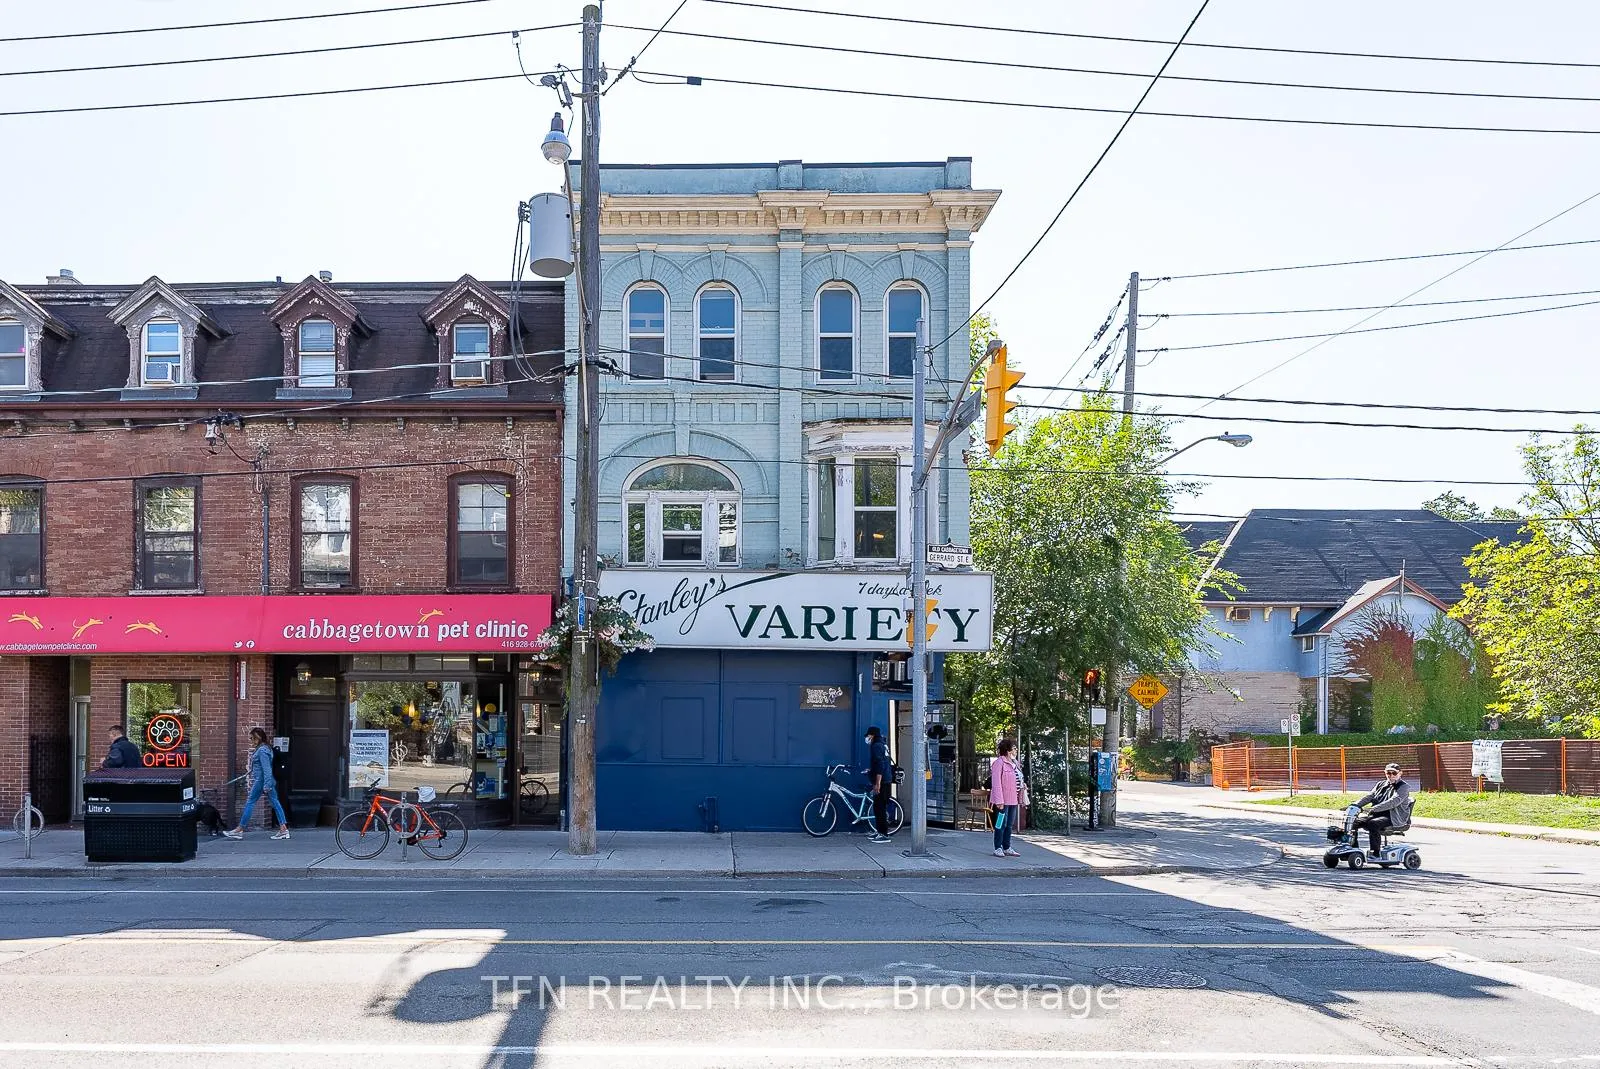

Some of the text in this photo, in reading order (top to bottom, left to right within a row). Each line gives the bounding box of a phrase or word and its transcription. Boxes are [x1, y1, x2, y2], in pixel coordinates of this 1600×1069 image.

[929, 553, 955, 563] GERRARD
[858, 582, 867, 594] 7
[617, 574, 728, 635] Stanley's
[283, 619, 529, 643] cabbagetown pet clinic
[501, 640, 515, 648] 416
[143, 752, 187, 767] OPEN
[88, 804, 103, 813] Litter
